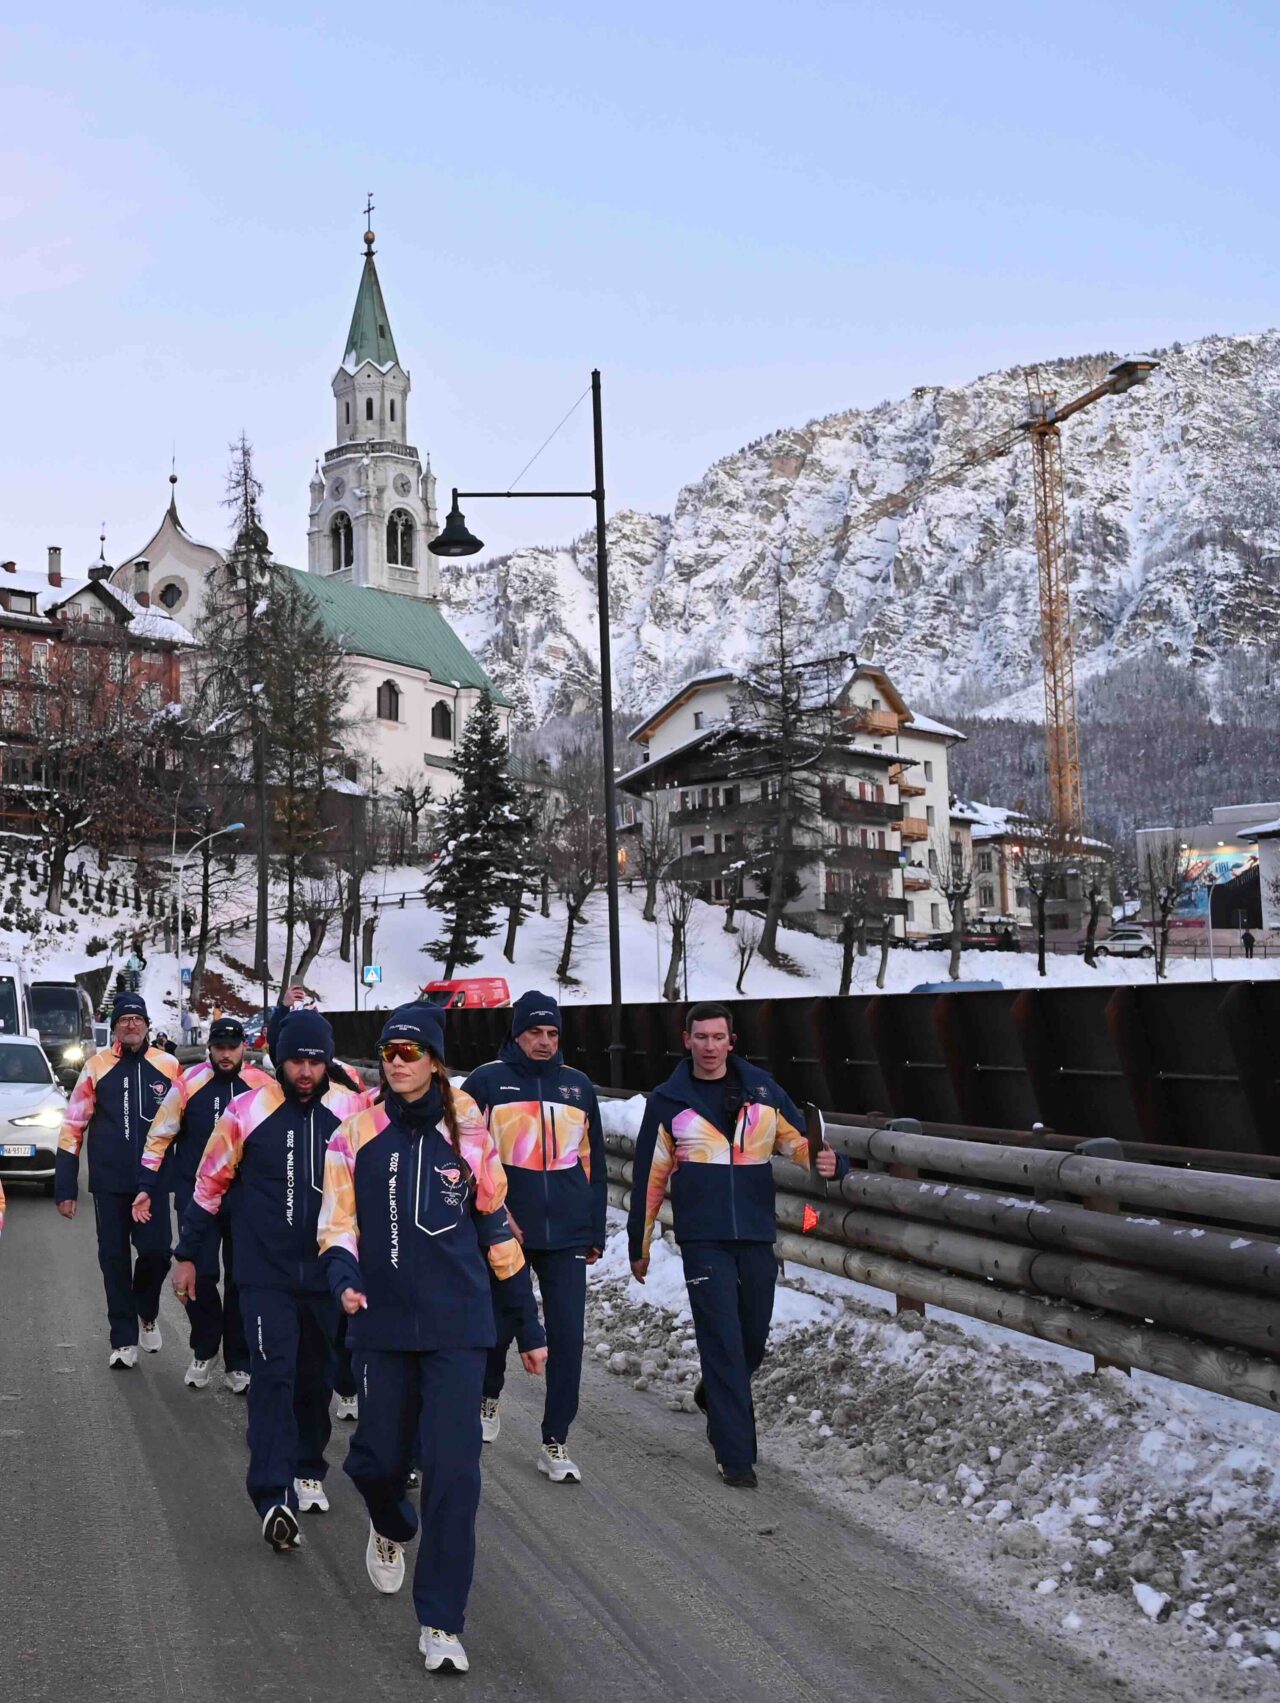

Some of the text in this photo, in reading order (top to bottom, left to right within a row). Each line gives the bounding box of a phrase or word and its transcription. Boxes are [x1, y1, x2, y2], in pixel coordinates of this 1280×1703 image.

[286, 1188, 294, 1227] MILANO
[389, 1152, 400, 1269] MILANO CORTINA 2026
